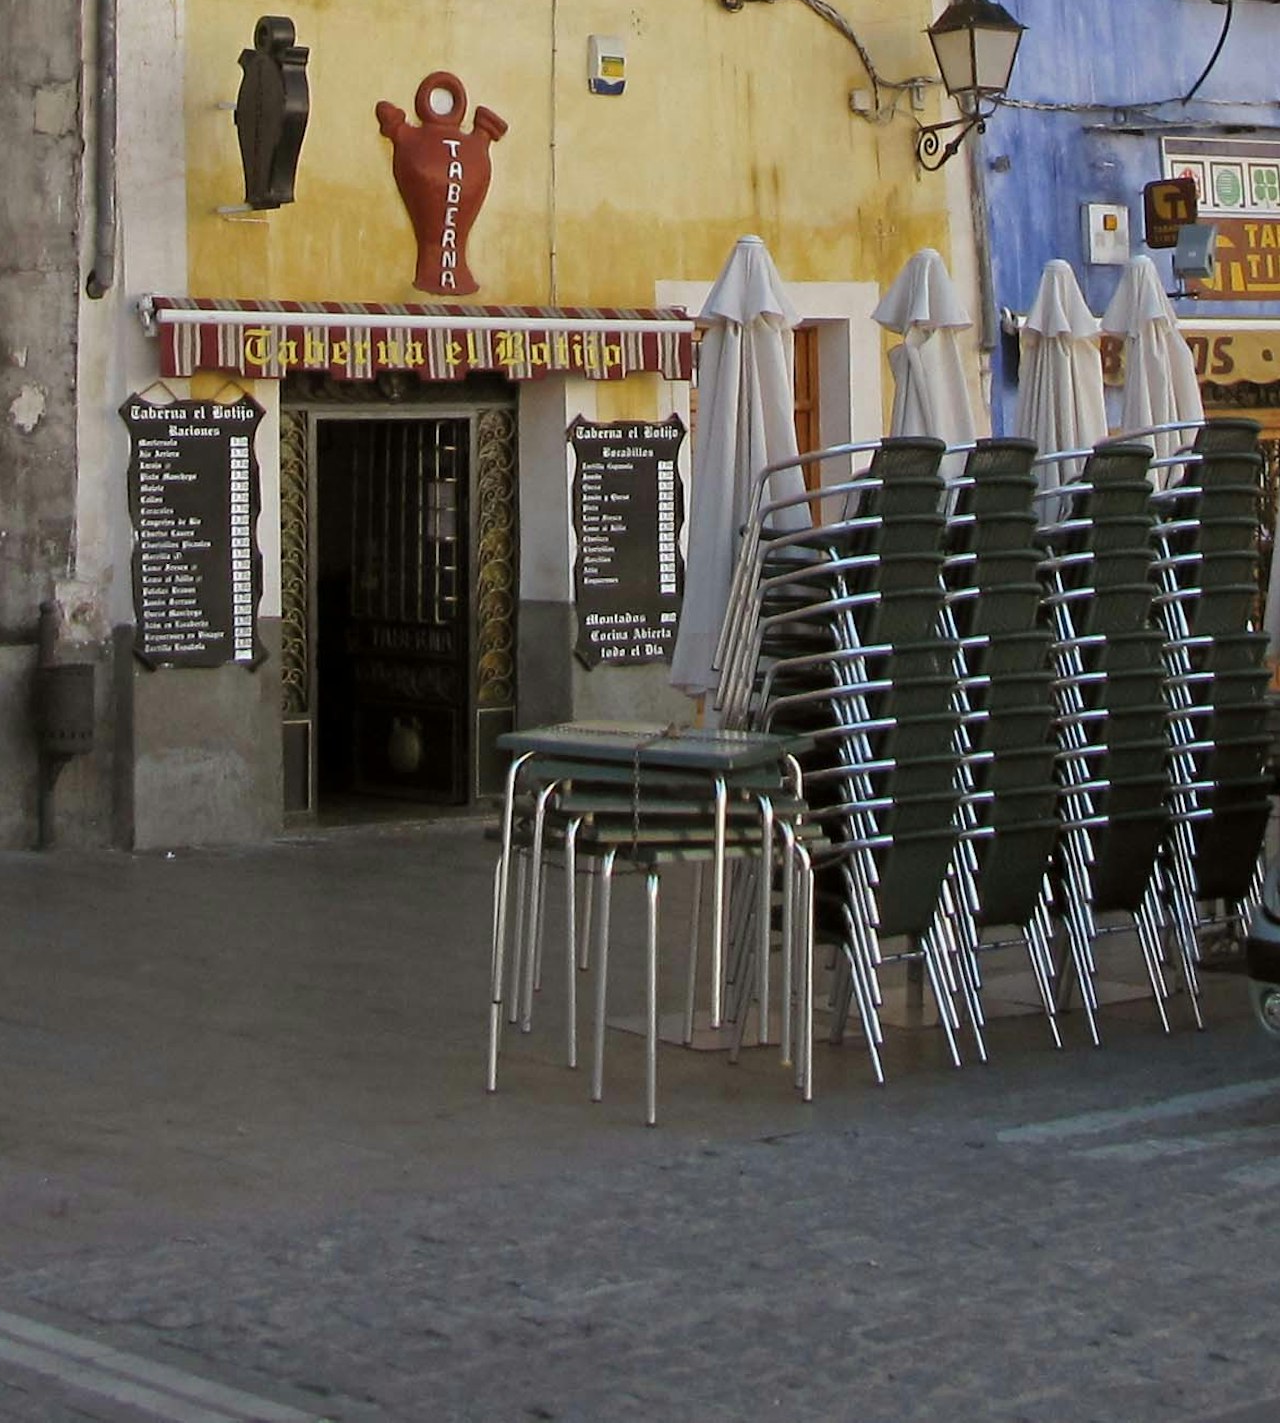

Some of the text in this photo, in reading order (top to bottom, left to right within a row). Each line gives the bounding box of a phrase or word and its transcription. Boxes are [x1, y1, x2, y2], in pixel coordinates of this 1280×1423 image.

[441, 139, 463, 289] TABERNA
[243, 328, 623, 371] Taberna el Botijo
[130, 404, 254, 421] Taberna el Botijo
[169, 424, 221, 437] Raciones
[576, 425, 679, 440] Taberna el Botijo
[602, 446, 654, 458] Bocadillos
[585, 612, 647, 625] Montados
[590, 627, 672, 642] Cocina Abierta
[601, 646, 626, 658] todo
[631, 645, 640, 656] el
